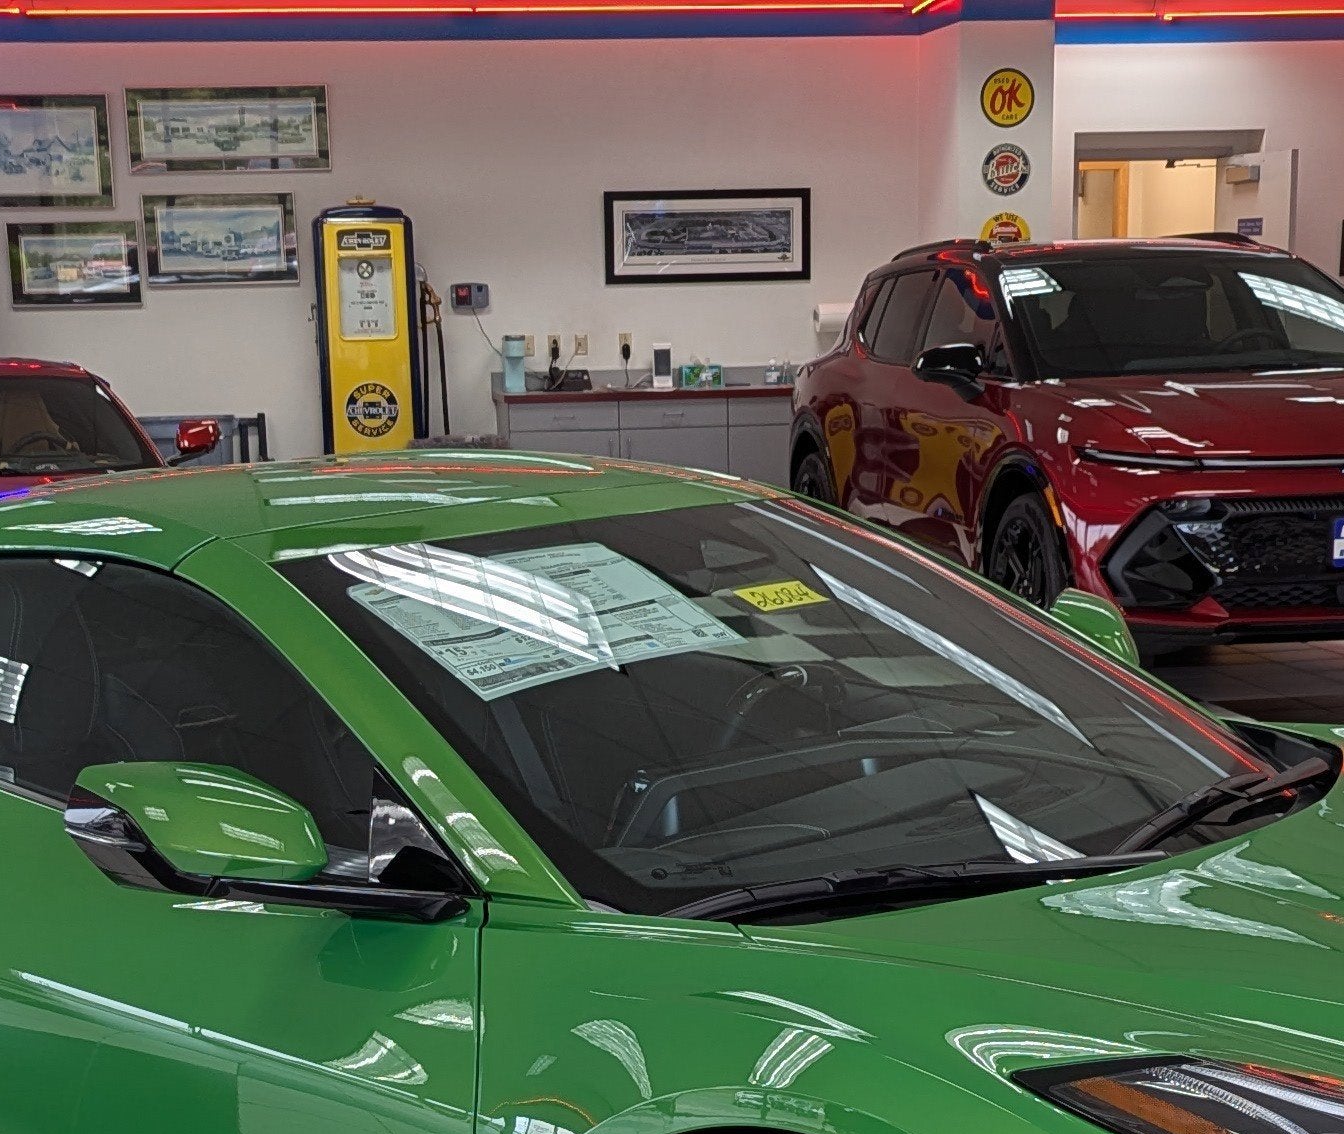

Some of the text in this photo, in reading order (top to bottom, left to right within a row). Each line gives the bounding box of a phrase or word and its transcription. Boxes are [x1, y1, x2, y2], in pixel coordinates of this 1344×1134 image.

[990, 78, 1025, 115] OK
[987, 157, 1027, 180] Buick
[353, 384, 391, 400] SUPER
[348, 405, 398, 417] CHEVROLET
[351, 419, 394, 436] SERVICE
